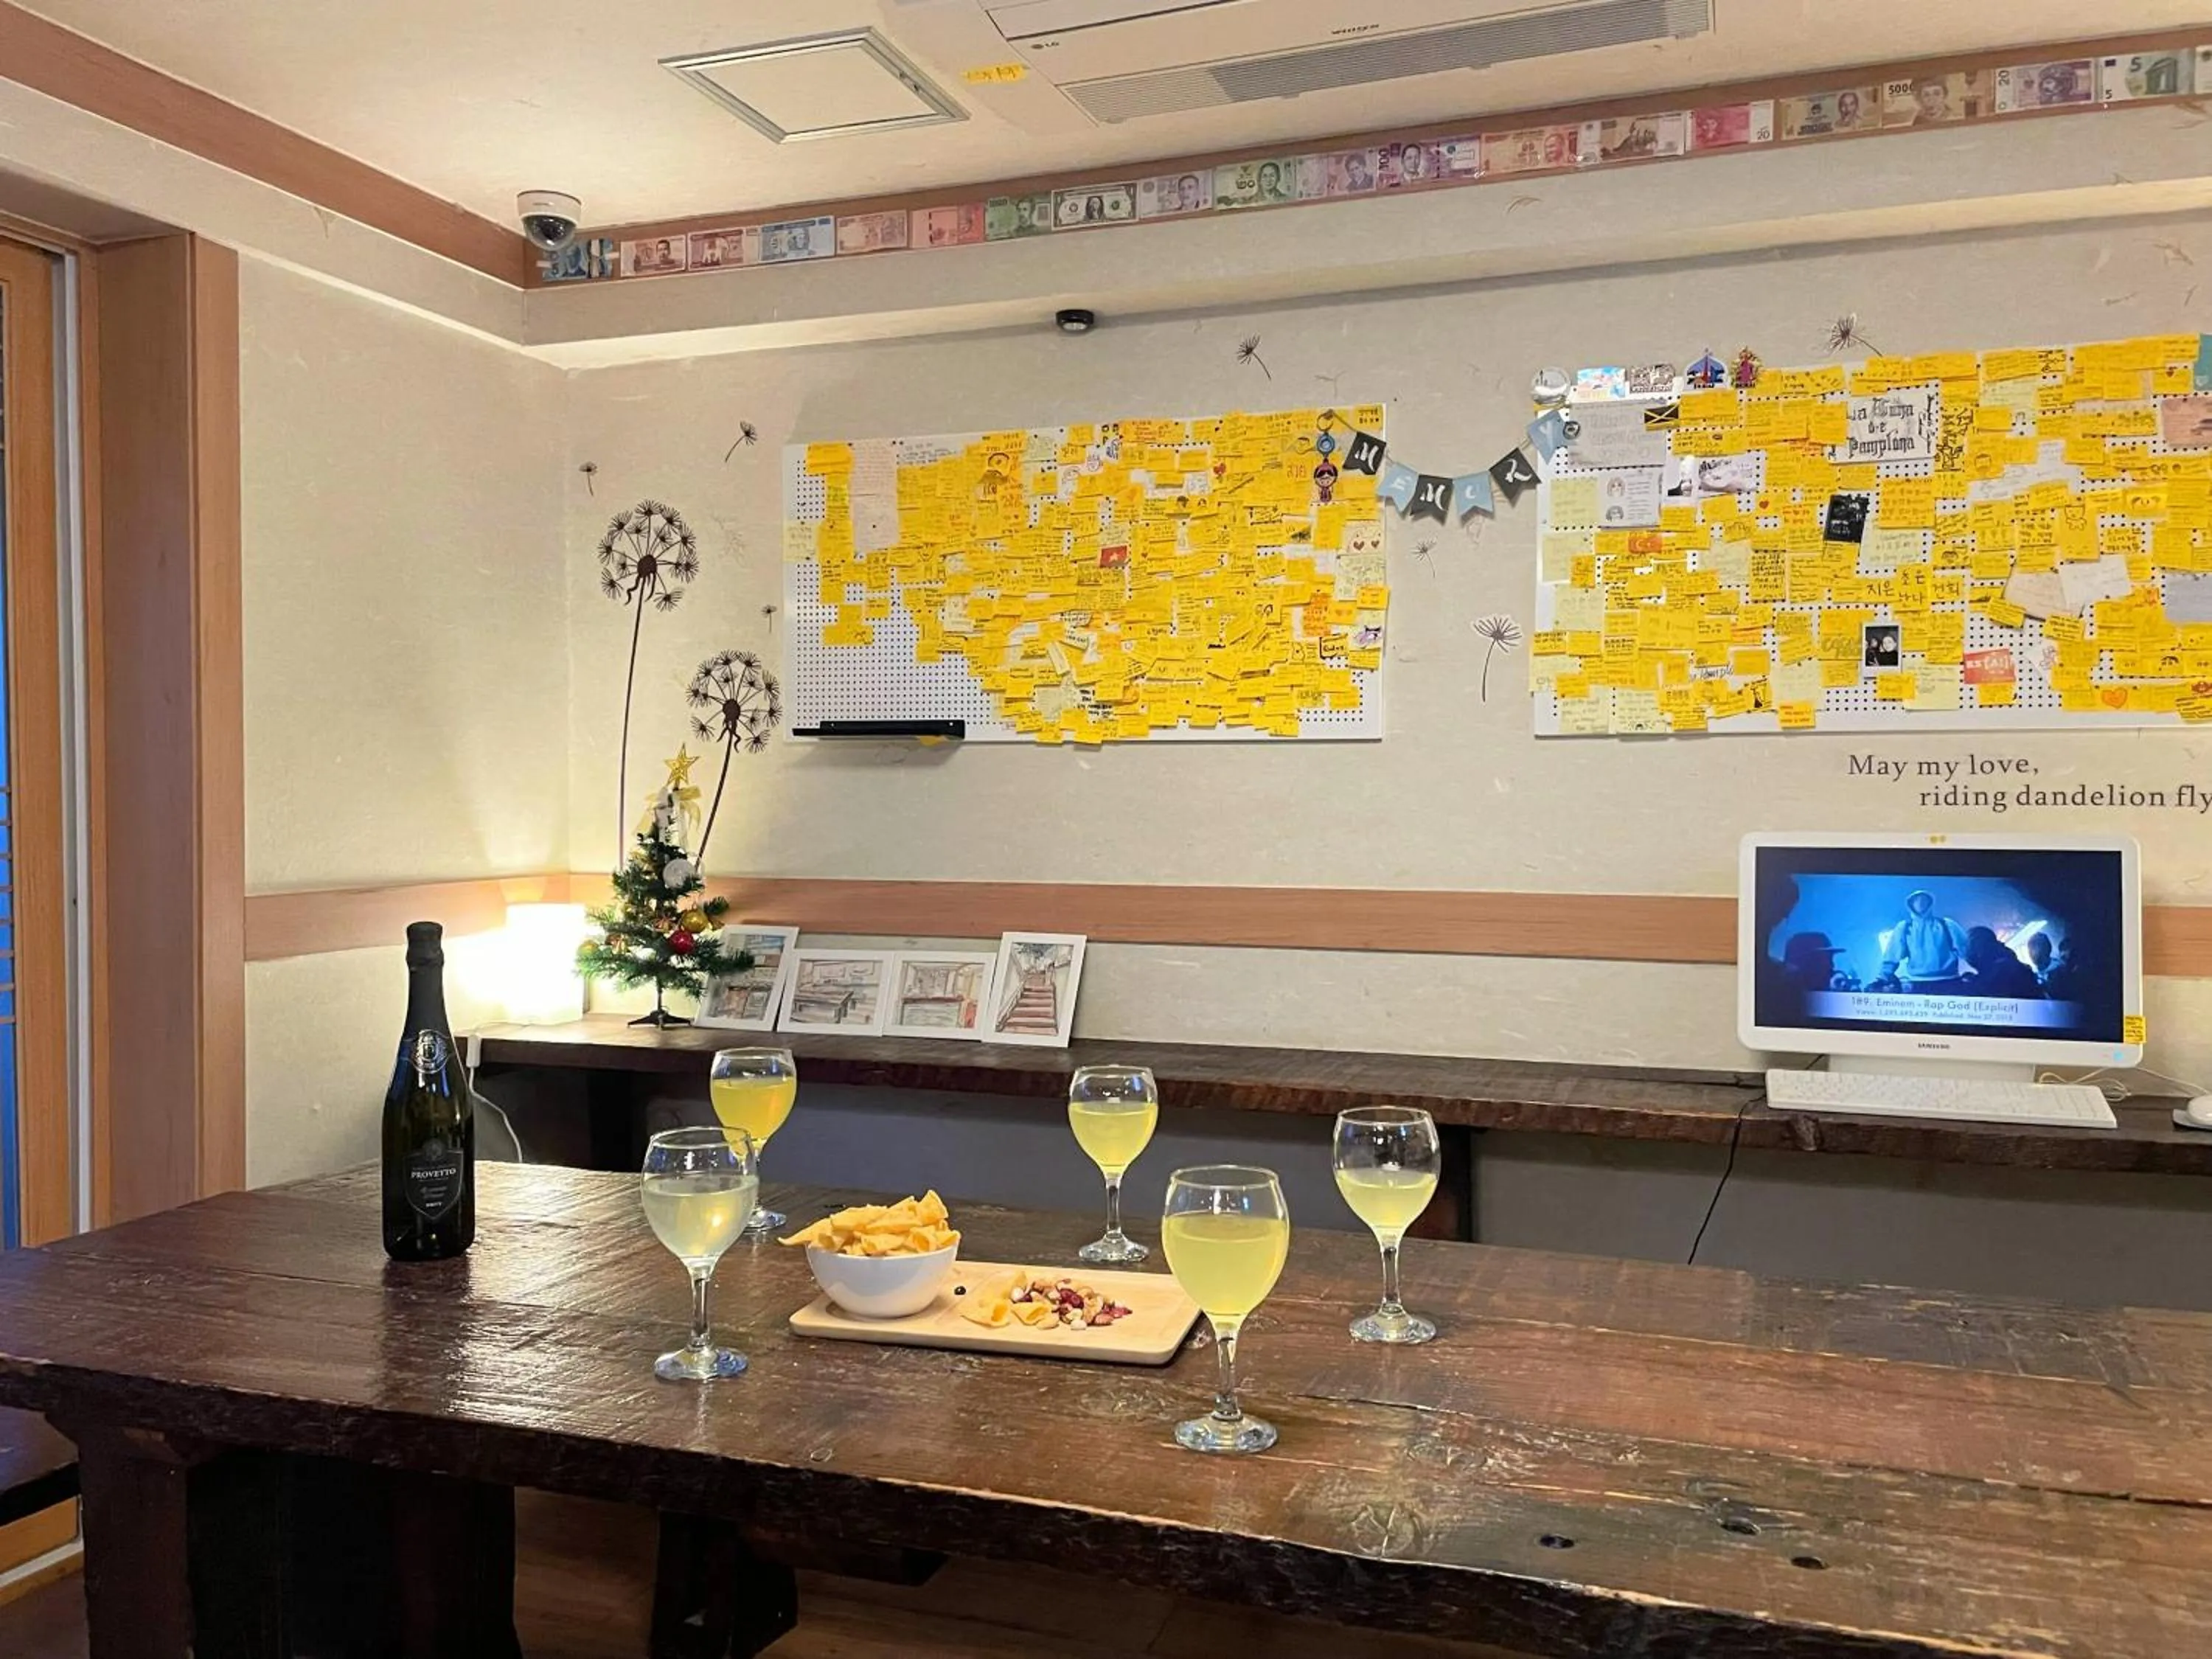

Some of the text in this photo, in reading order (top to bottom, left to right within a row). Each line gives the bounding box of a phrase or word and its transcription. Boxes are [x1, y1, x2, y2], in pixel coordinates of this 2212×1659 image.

[2129, 56, 2142, 73] 5
[2104, 89, 2113, 100] 5
[1847, 754, 2039, 782] May my love,
[1919, 784, 2212, 814] riding dandelion fly
[1877, 998, 1915, 1008] Eminem
[1924, 999, 1944, 1010] Rap
[1947, 1000, 1971, 1009] God
[411, 1167, 456, 1179] PROVETTO
